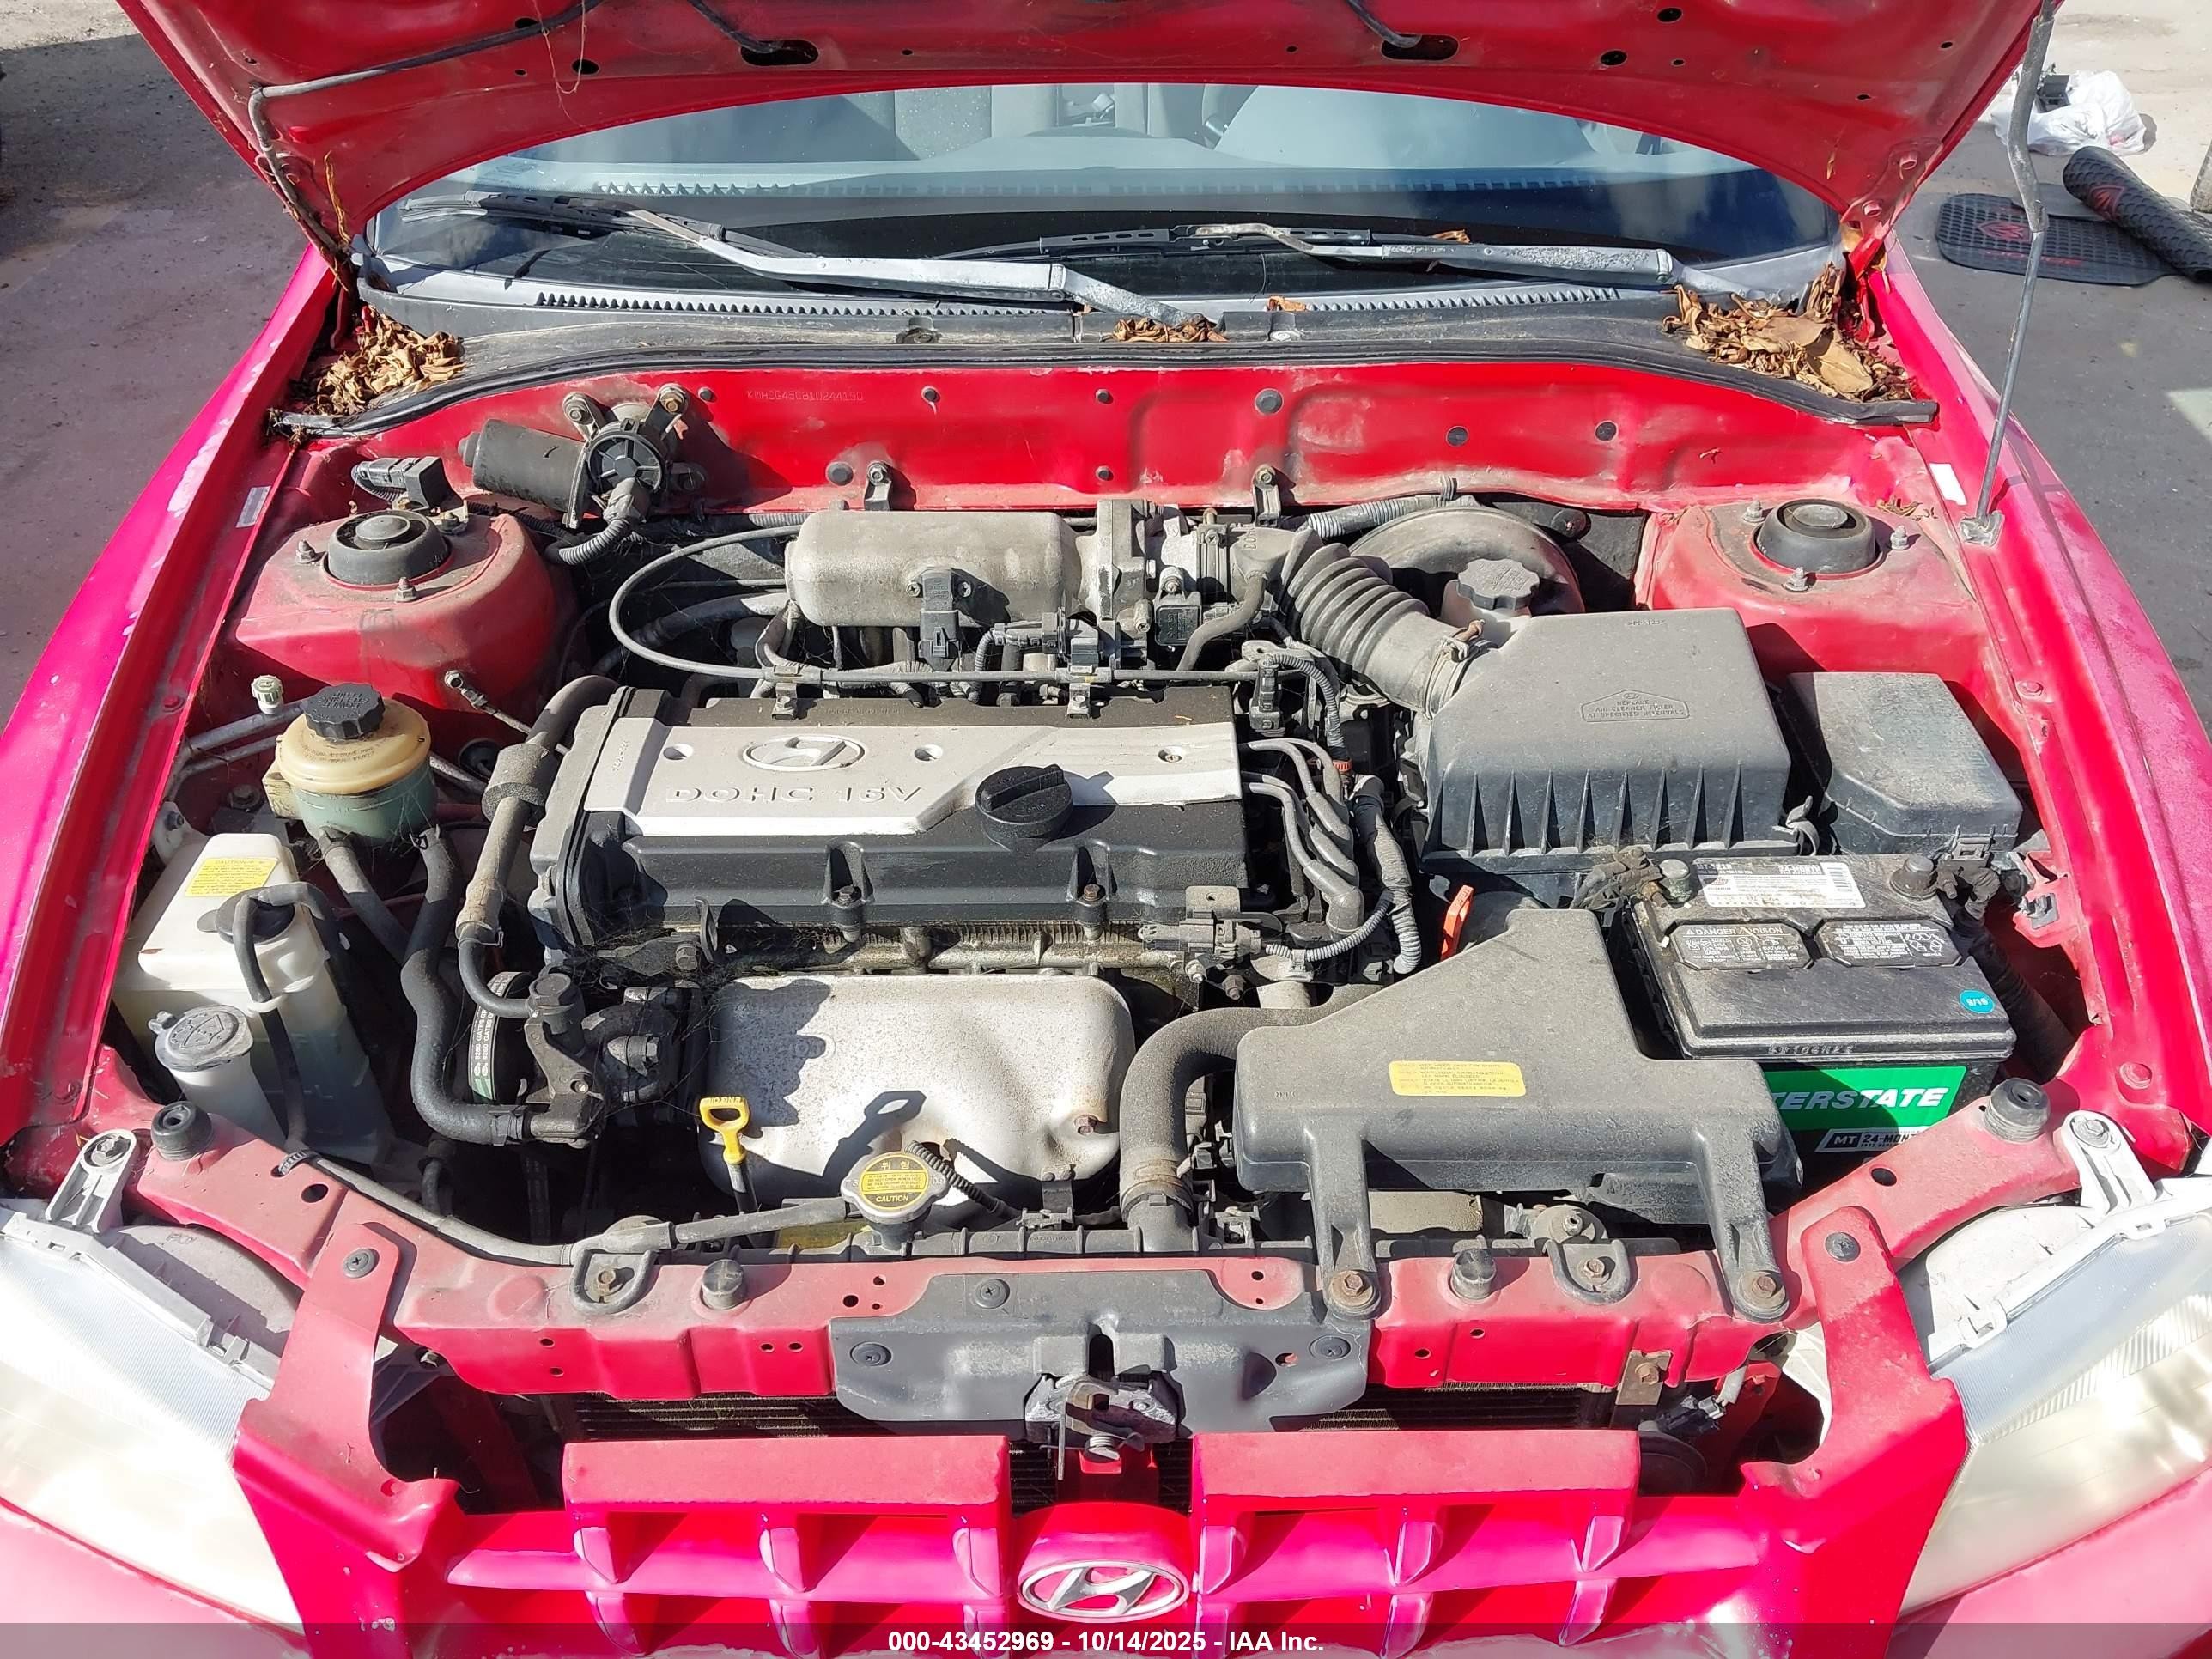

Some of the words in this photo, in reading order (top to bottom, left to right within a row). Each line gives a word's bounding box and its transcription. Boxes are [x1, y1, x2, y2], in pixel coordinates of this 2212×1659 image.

[665, 787, 814, 803] DOHC
[839, 785, 923, 803] 16V
[476, 1019, 485, 1042] GATES
[483, 1019, 493, 1042] GATES
[1834, 1135, 1857, 1145] MT
[1862, 1133, 1917, 1144] 24-MON
[876, 1194, 909, 1203] CAUTION
